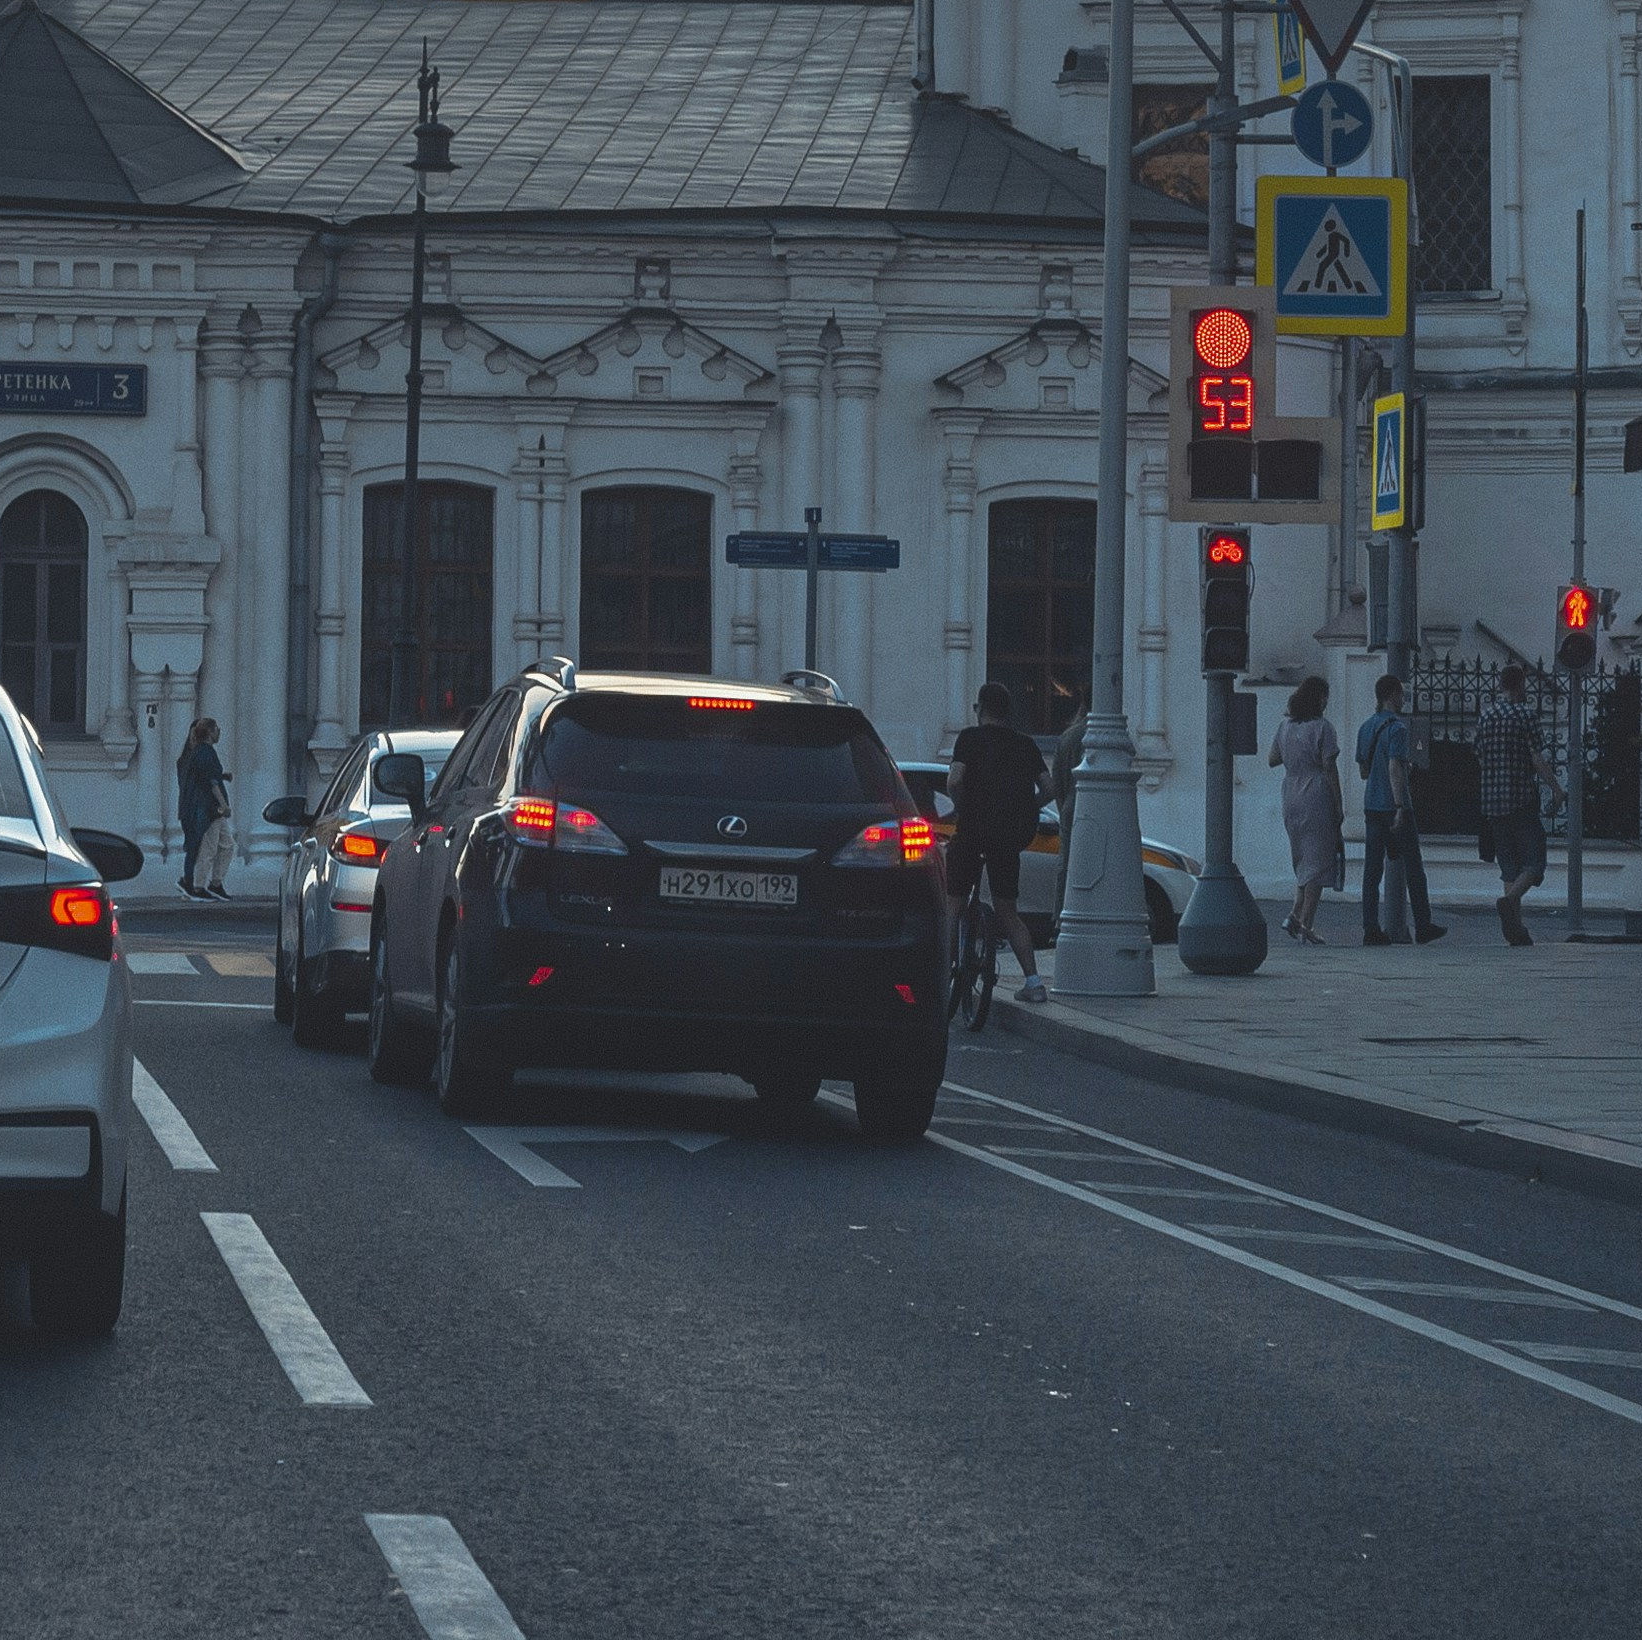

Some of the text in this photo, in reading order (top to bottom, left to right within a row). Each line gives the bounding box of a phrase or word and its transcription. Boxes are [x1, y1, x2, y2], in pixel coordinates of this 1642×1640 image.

[5, 394, 46, 403] УЛИЦА
[112, 374, 130, 400] 3
[1199, 376, 1254, 431] 53
[760, 875, 792, 896] 199
